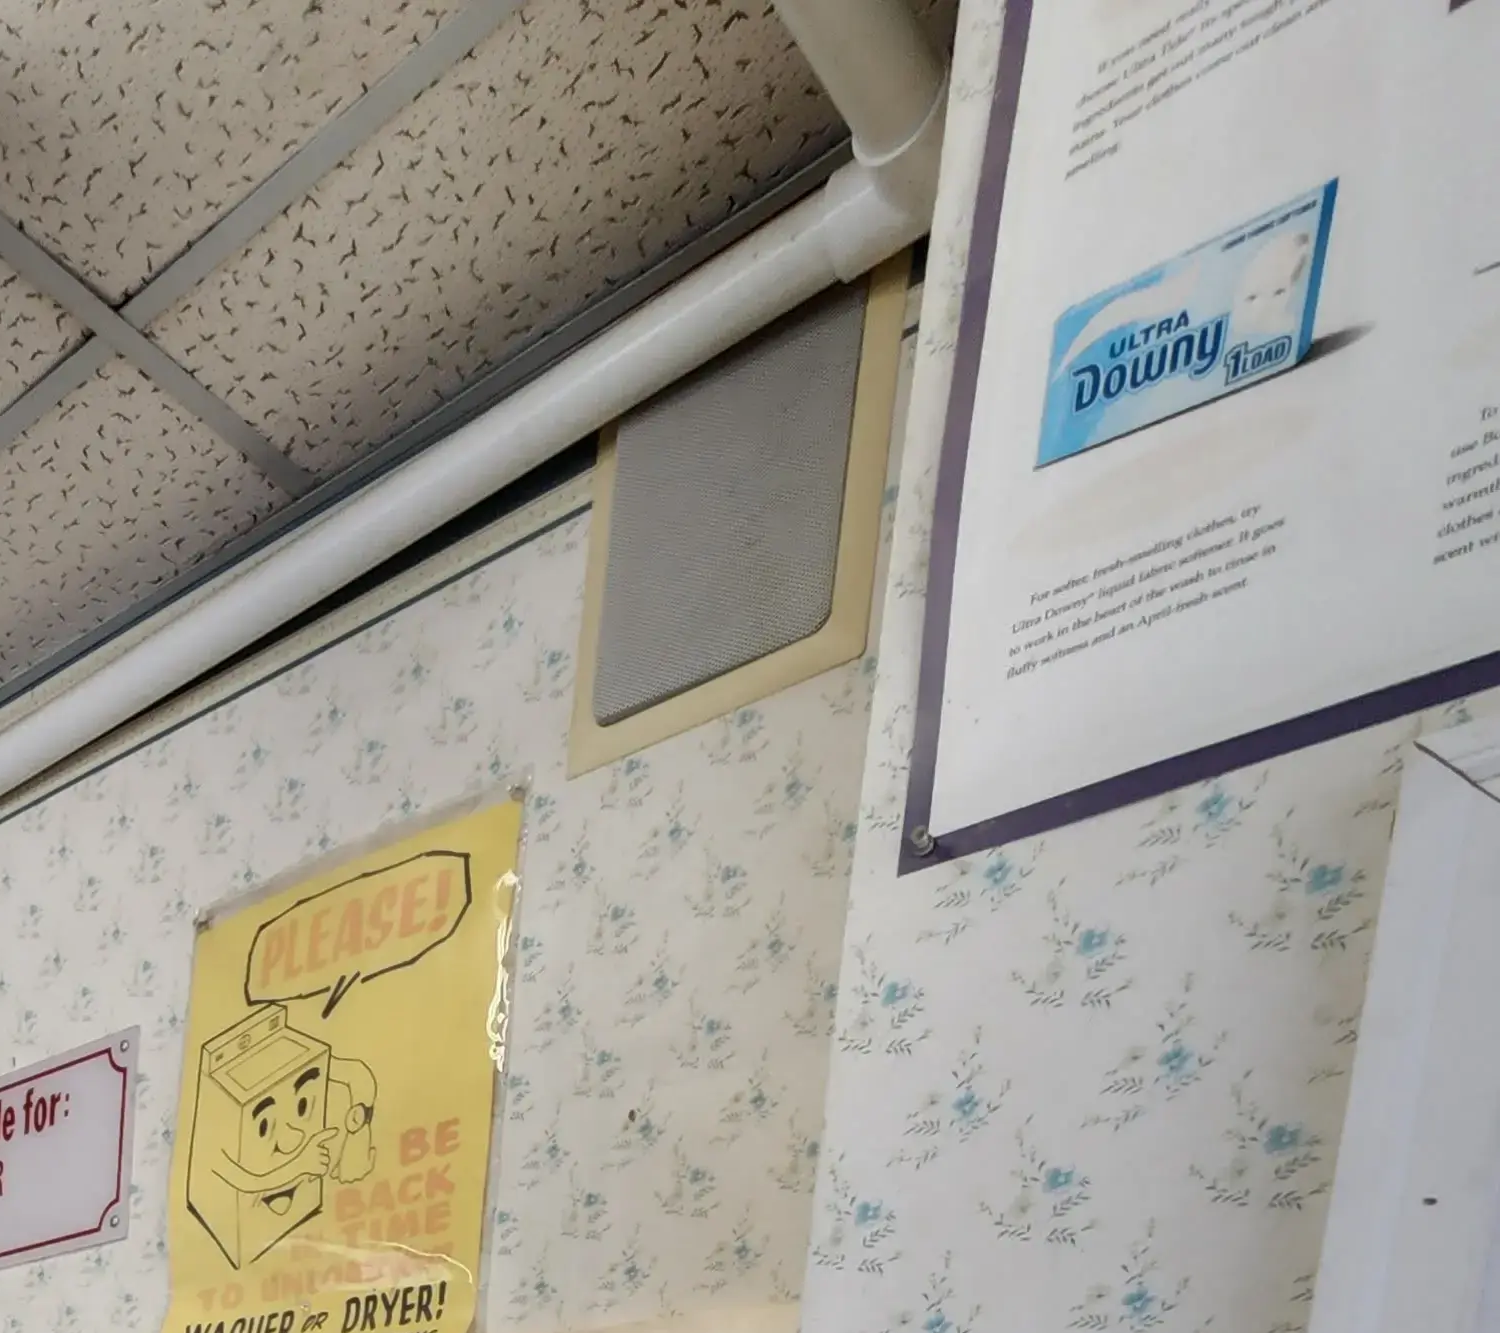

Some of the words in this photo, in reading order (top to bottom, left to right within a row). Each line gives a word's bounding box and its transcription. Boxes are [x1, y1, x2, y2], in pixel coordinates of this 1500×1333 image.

[1108, 309, 1190, 360] ULTRA
[1072, 319, 1224, 413] Downy
[1011, 615, 1042, 634] Ultra
[1098, 574, 1136, 600] liquid
[1030, 590, 1050, 605] For
[1024, 631, 1054, 651] work
[1057, 625, 1069, 639] in
[1071, 614, 1092, 632] the
[1091, 626, 1116, 647] and
[1117, 620, 1135, 635] an
[260, 868, 454, 989] PLEASE!
[22, 1087, 70, 1136] for:
[401, 1117, 461, 1167] BE
[335, 1163, 456, 1222] BACK
[341, 1201, 451, 1249] TIME
[197, 1282, 244, 1312] TO
[301, 1311, 329, 1333] OR
[341, 1281, 447, 1333] DRYER!
